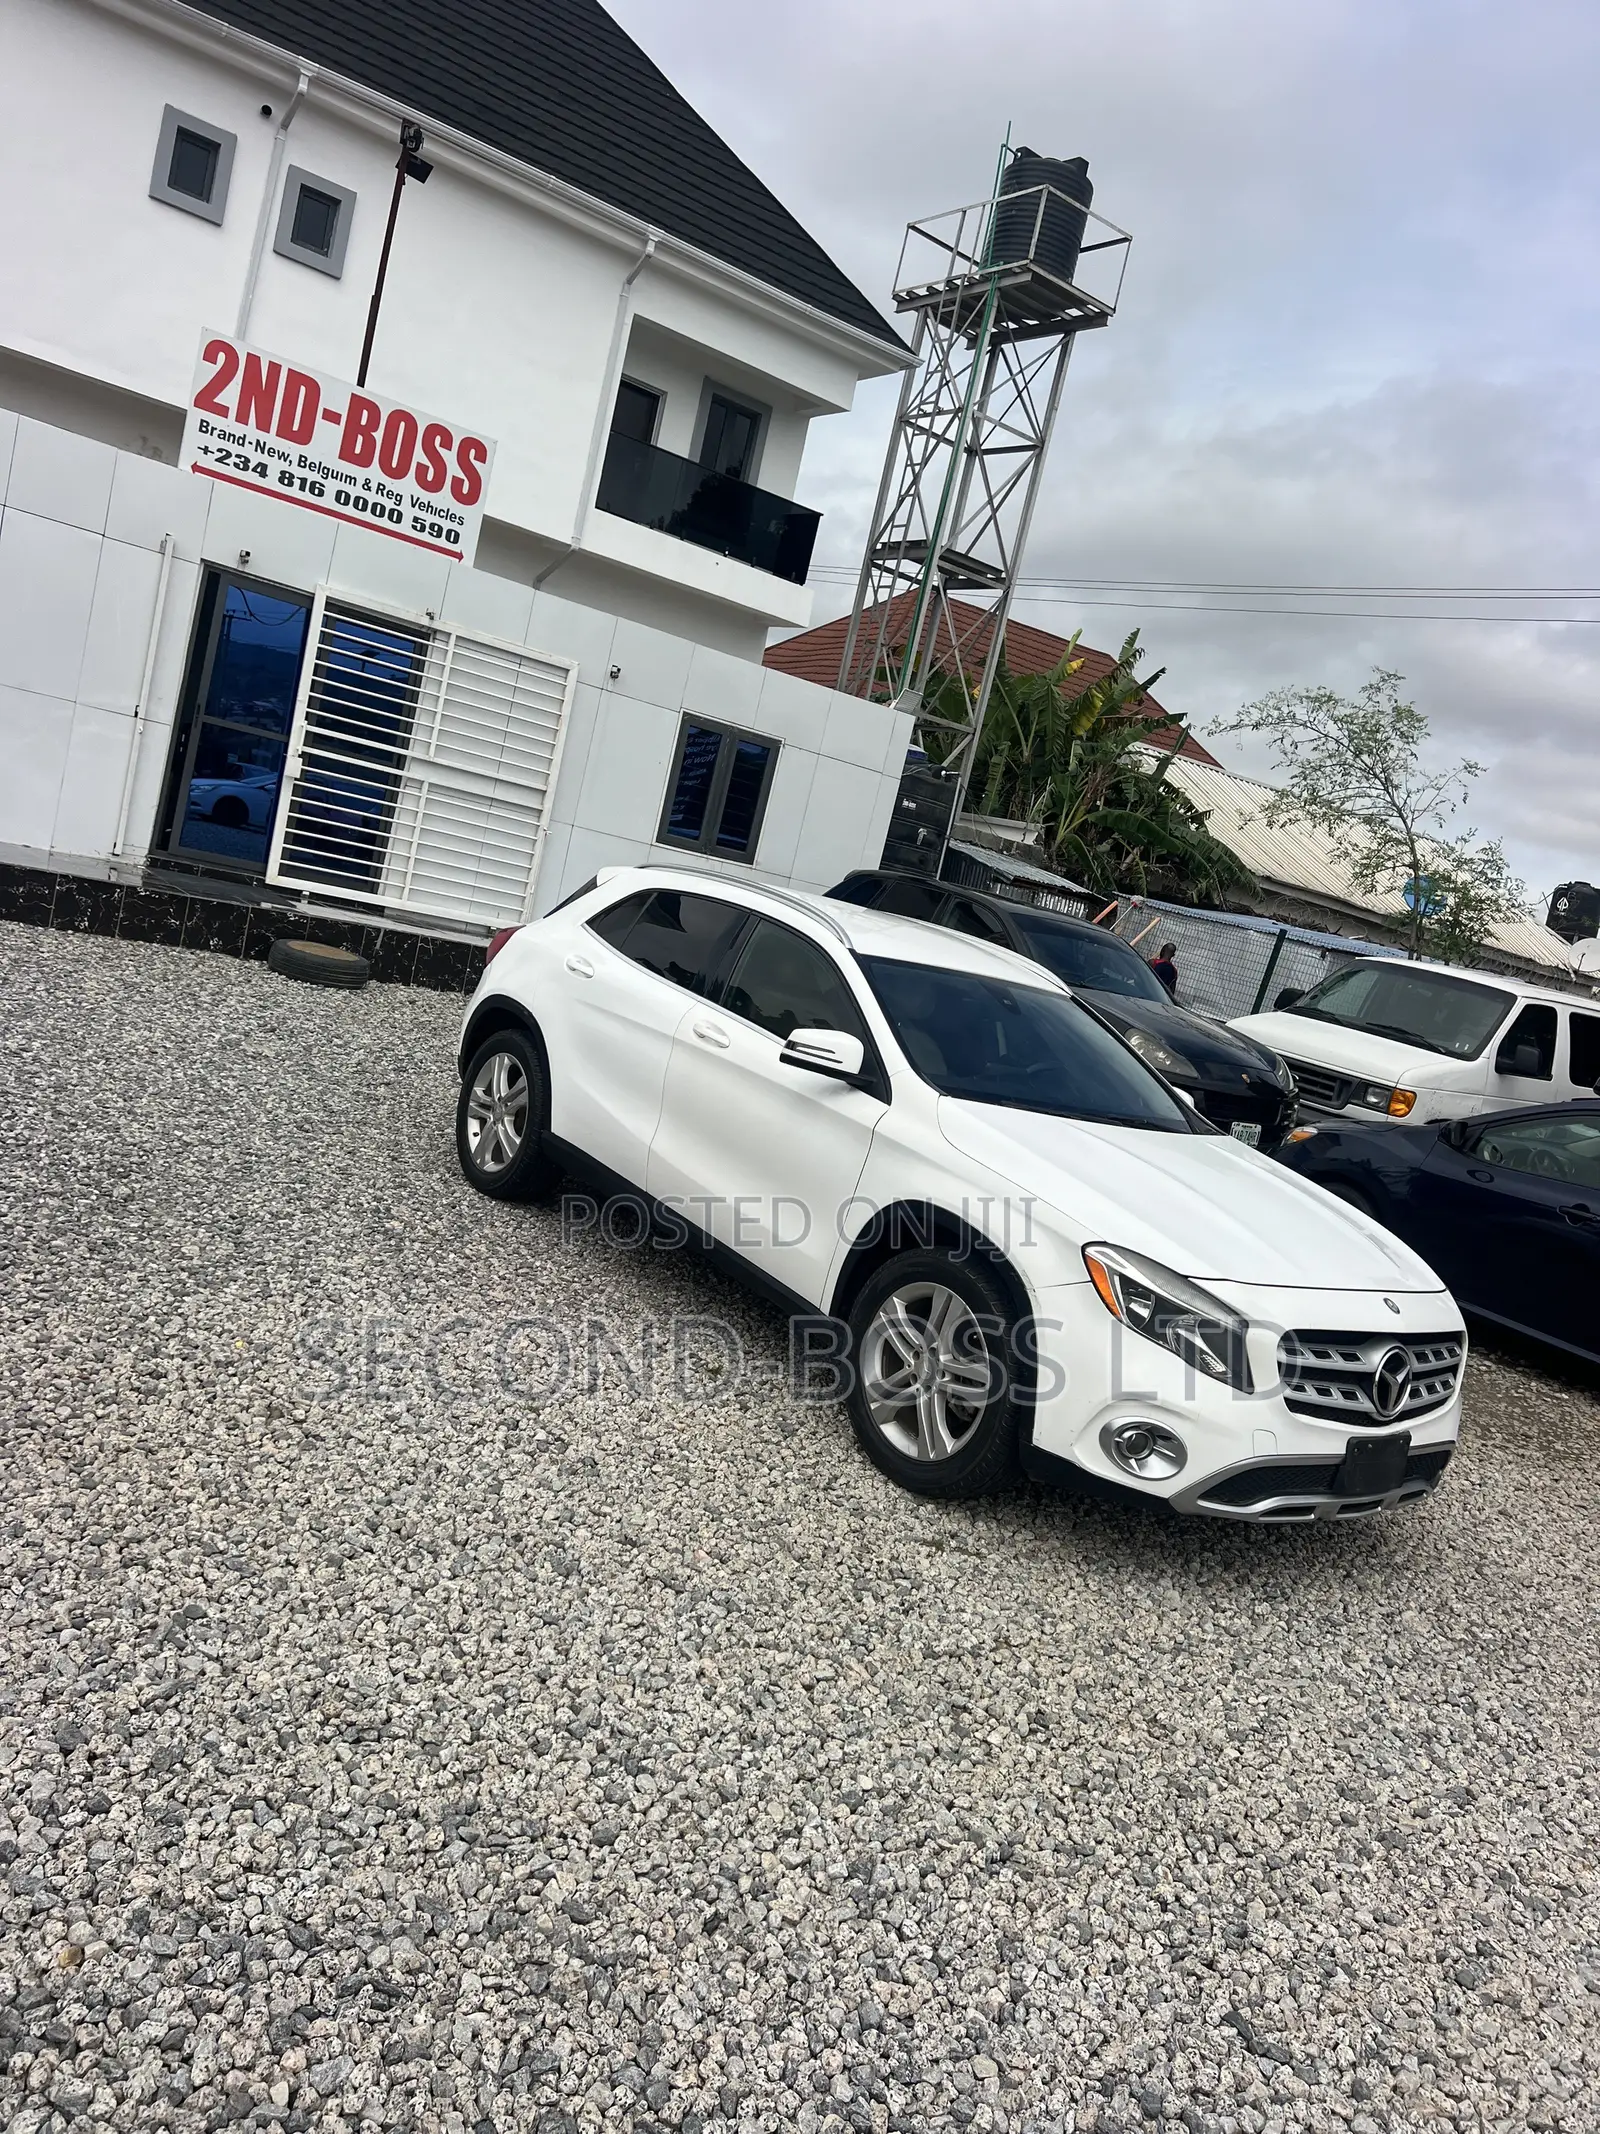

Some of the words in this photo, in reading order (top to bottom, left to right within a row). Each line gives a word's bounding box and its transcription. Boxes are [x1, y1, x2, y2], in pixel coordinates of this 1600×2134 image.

[193, 339, 488, 506] 2ND-BOSS
[197, 445, 268, 479] +234
[277, 470, 326, 498] 816
[334, 489, 403, 525] 0000
[411, 515, 460, 544] 590
[297, 454, 357, 487] Belguim
[362, 478, 372, 492] &
[375, 482, 403, 506] Reg
[410, 494, 465, 526] Vehicles
